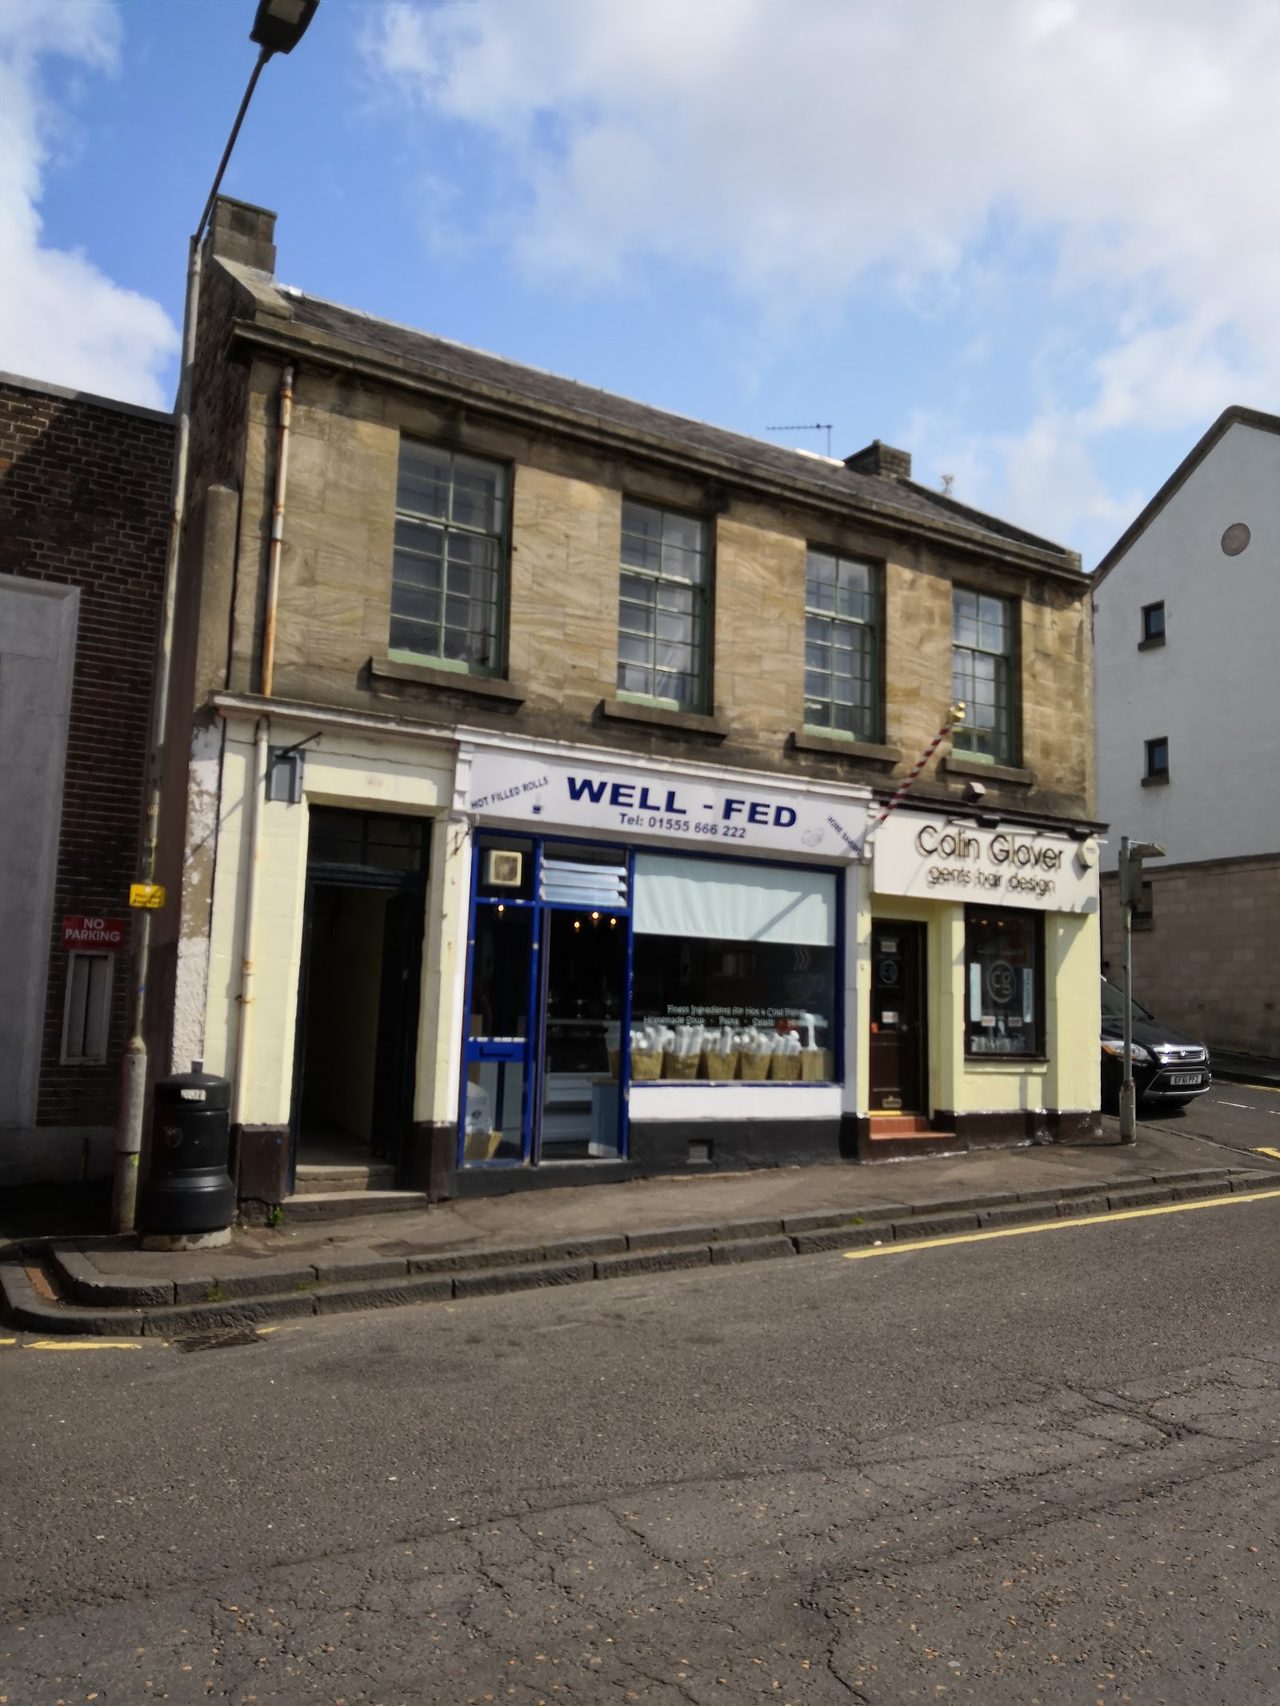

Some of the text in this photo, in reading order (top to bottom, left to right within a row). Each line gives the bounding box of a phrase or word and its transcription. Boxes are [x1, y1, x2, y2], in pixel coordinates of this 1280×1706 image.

[567, 776, 687, 815] WELL
[722, 798, 797, 828] FED
[619, 813, 746, 839] Tel: 01555 666 222
[916, 825, 1064, 870] Colin Glover
[927, 866, 1056, 898] gents hair design
[64, 918, 121, 942] NO PARKING
